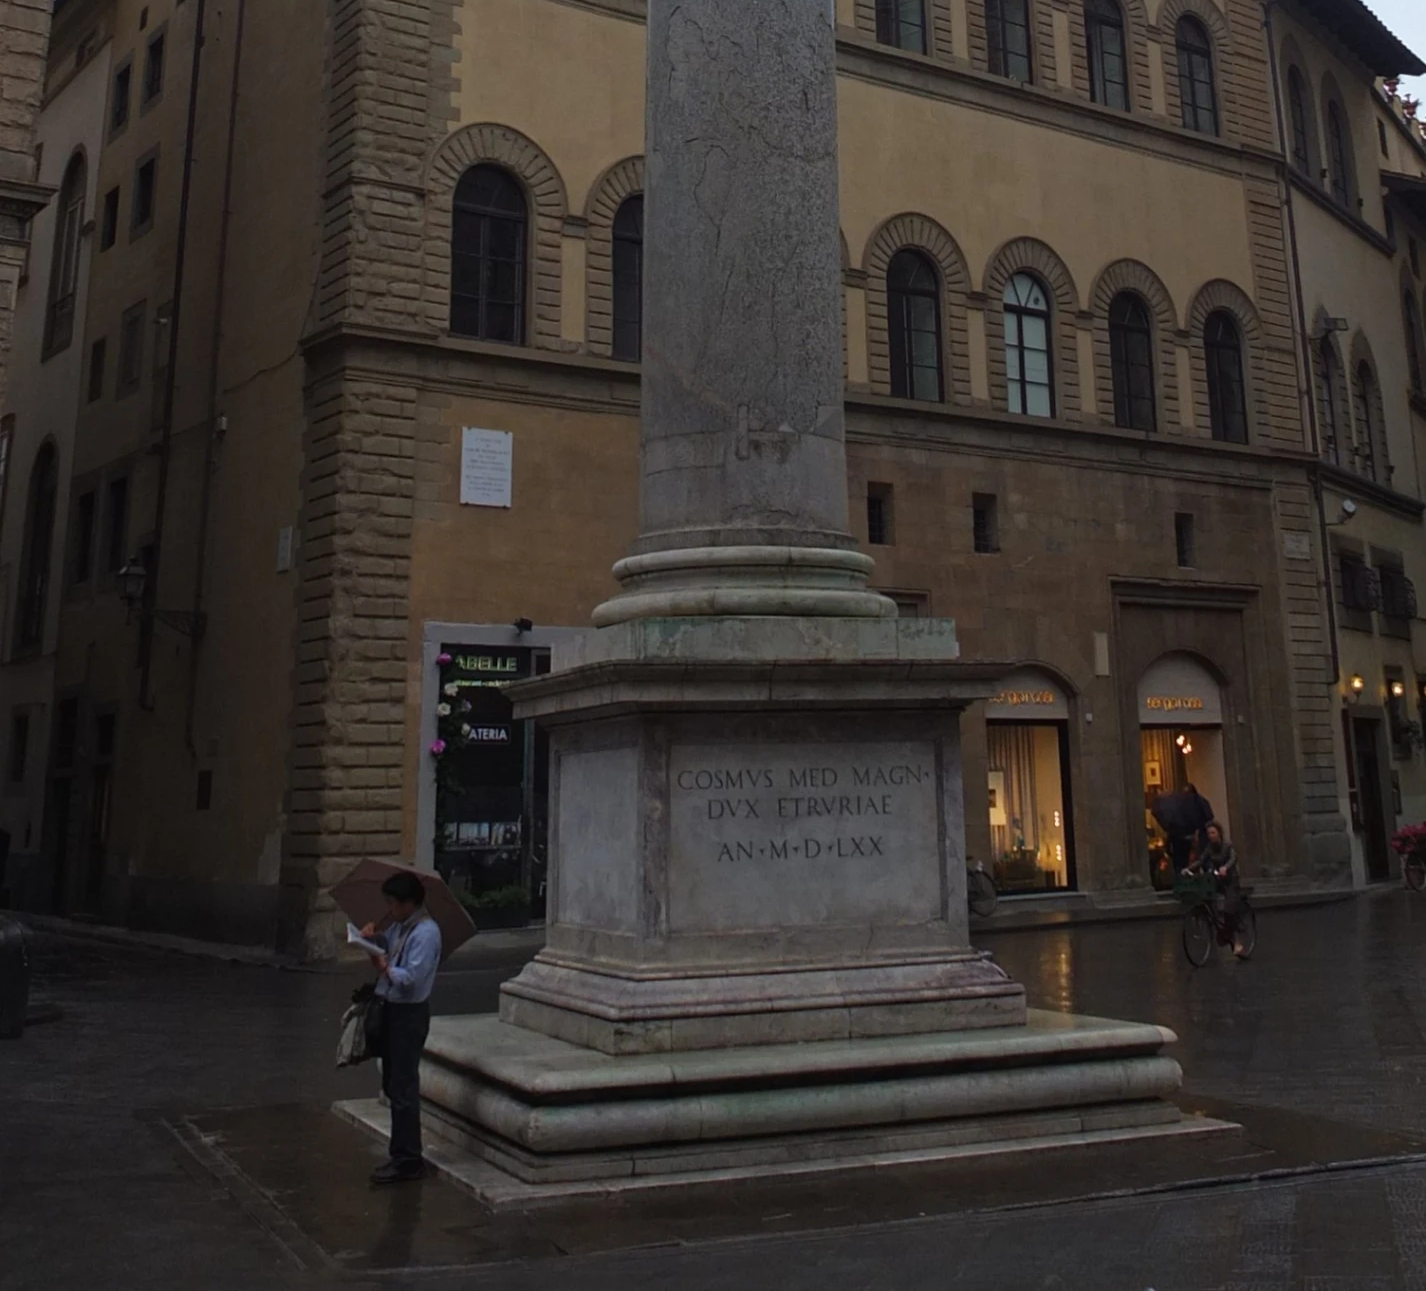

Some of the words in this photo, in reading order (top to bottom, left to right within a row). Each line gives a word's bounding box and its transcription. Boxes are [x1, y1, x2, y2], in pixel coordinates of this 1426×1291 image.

[676, 768, 774, 791] COSMVS
[789, 767, 838, 789] MED
[707, 797, 761, 820] DVX
[777, 794, 893, 818] ETRVRIAE
